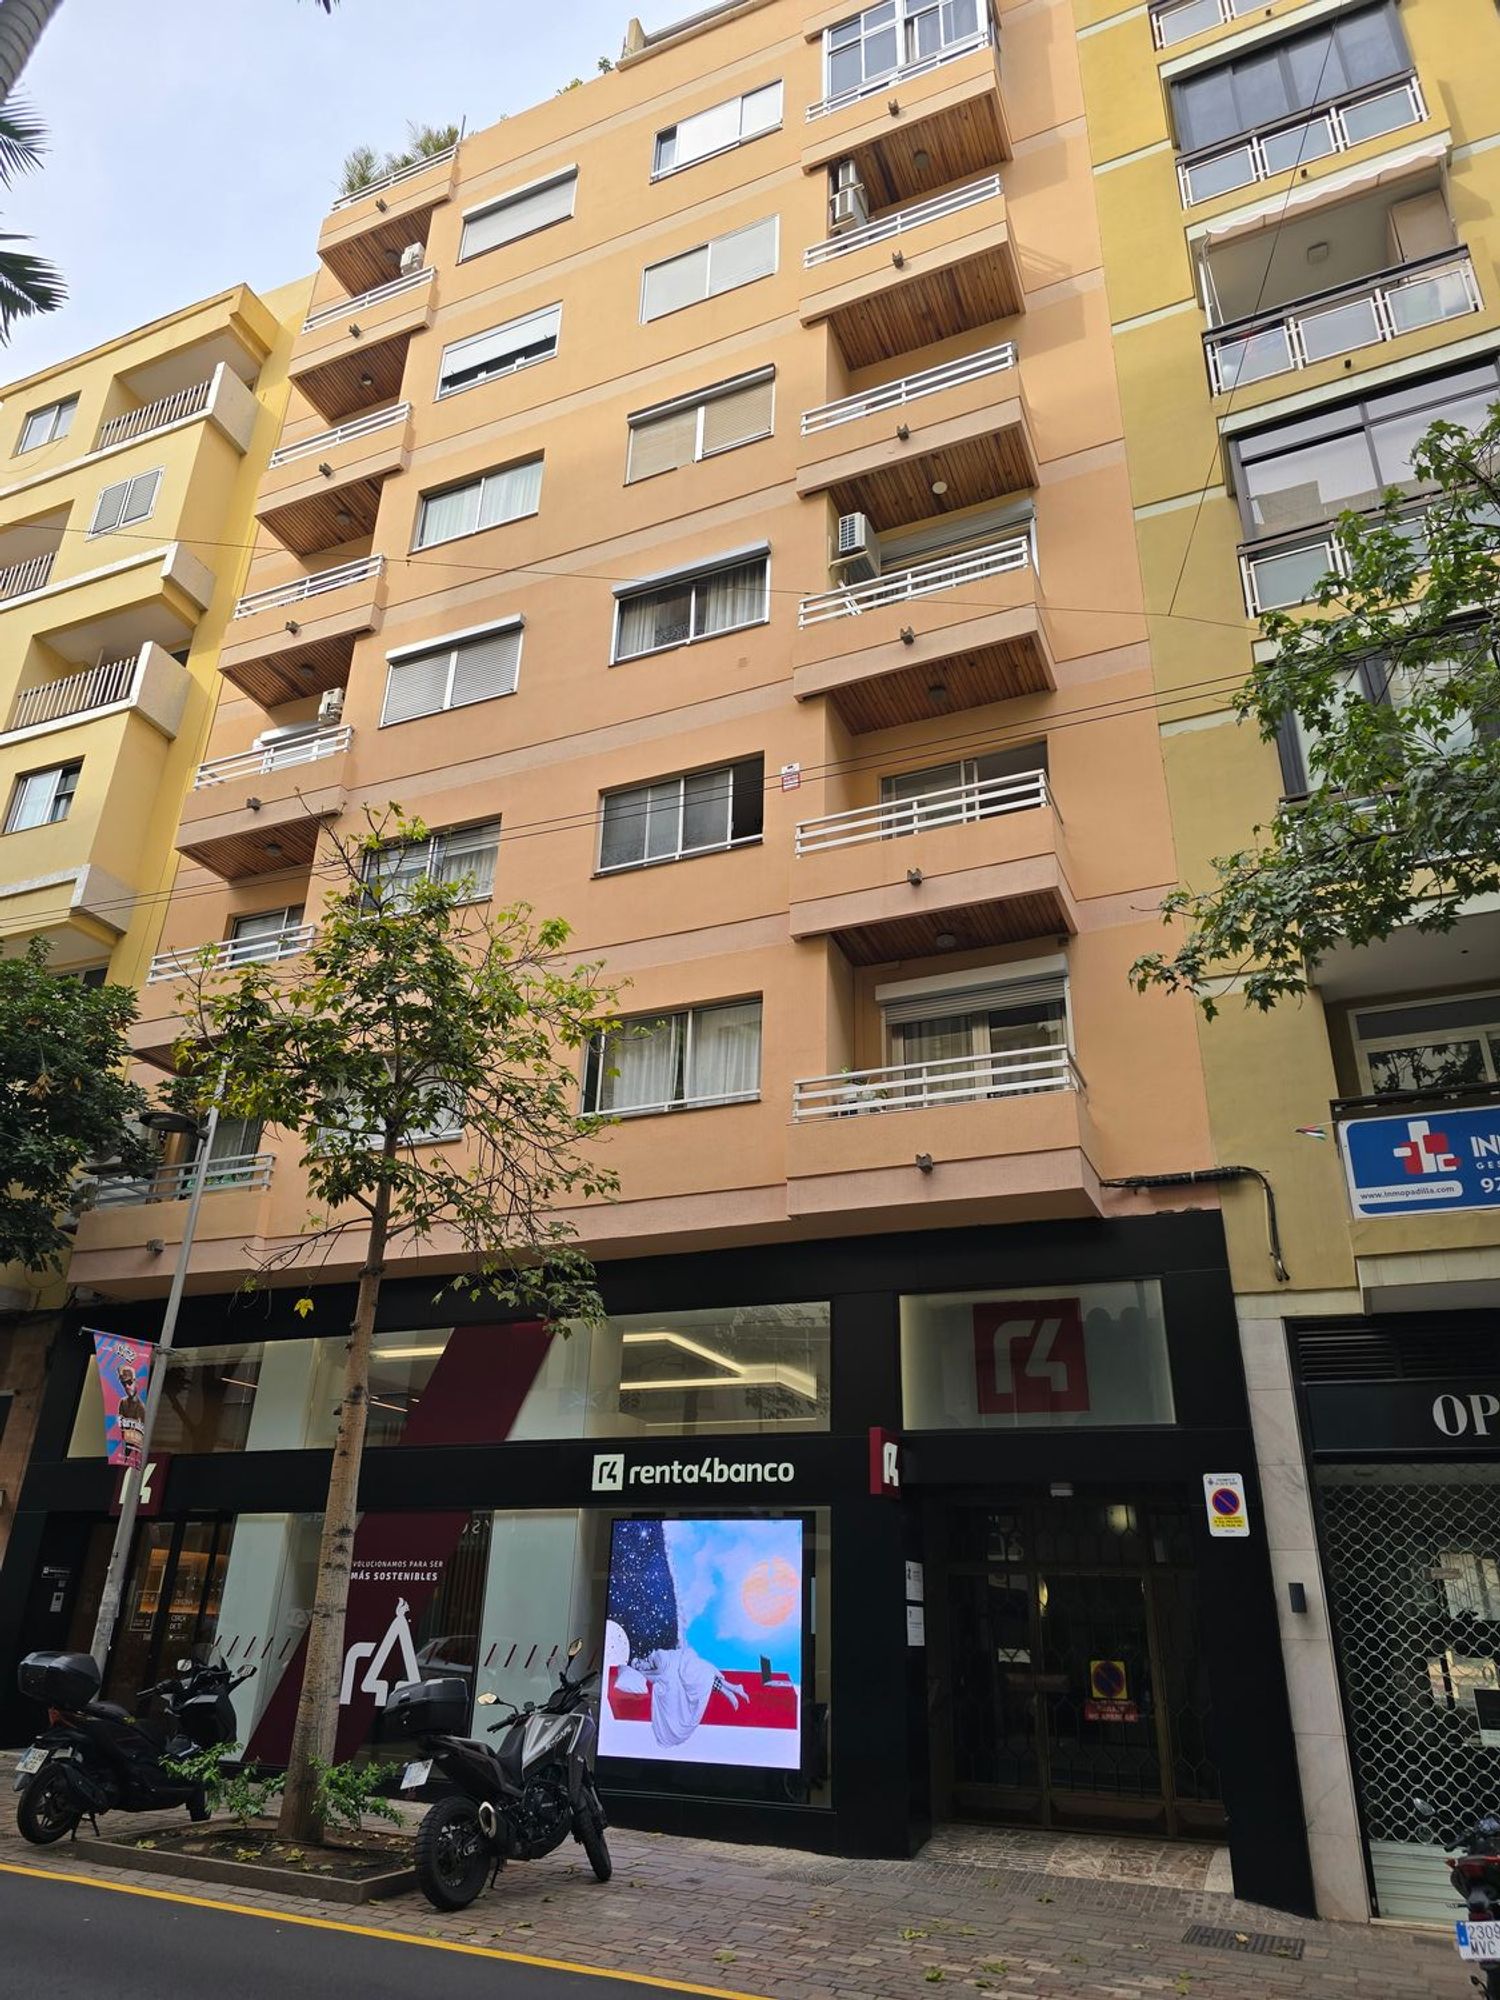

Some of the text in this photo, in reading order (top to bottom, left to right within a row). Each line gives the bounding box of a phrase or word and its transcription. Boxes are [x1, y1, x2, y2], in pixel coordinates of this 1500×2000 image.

[1470, 1133, 1500, 1158] IN
[629, 1457, 795, 1484] renta4banco
[409, 1560, 428, 1568] PARA
[429, 1560, 444, 1568] SER
[350, 1569, 438, 1581] MÁS SOSTENIBLES
